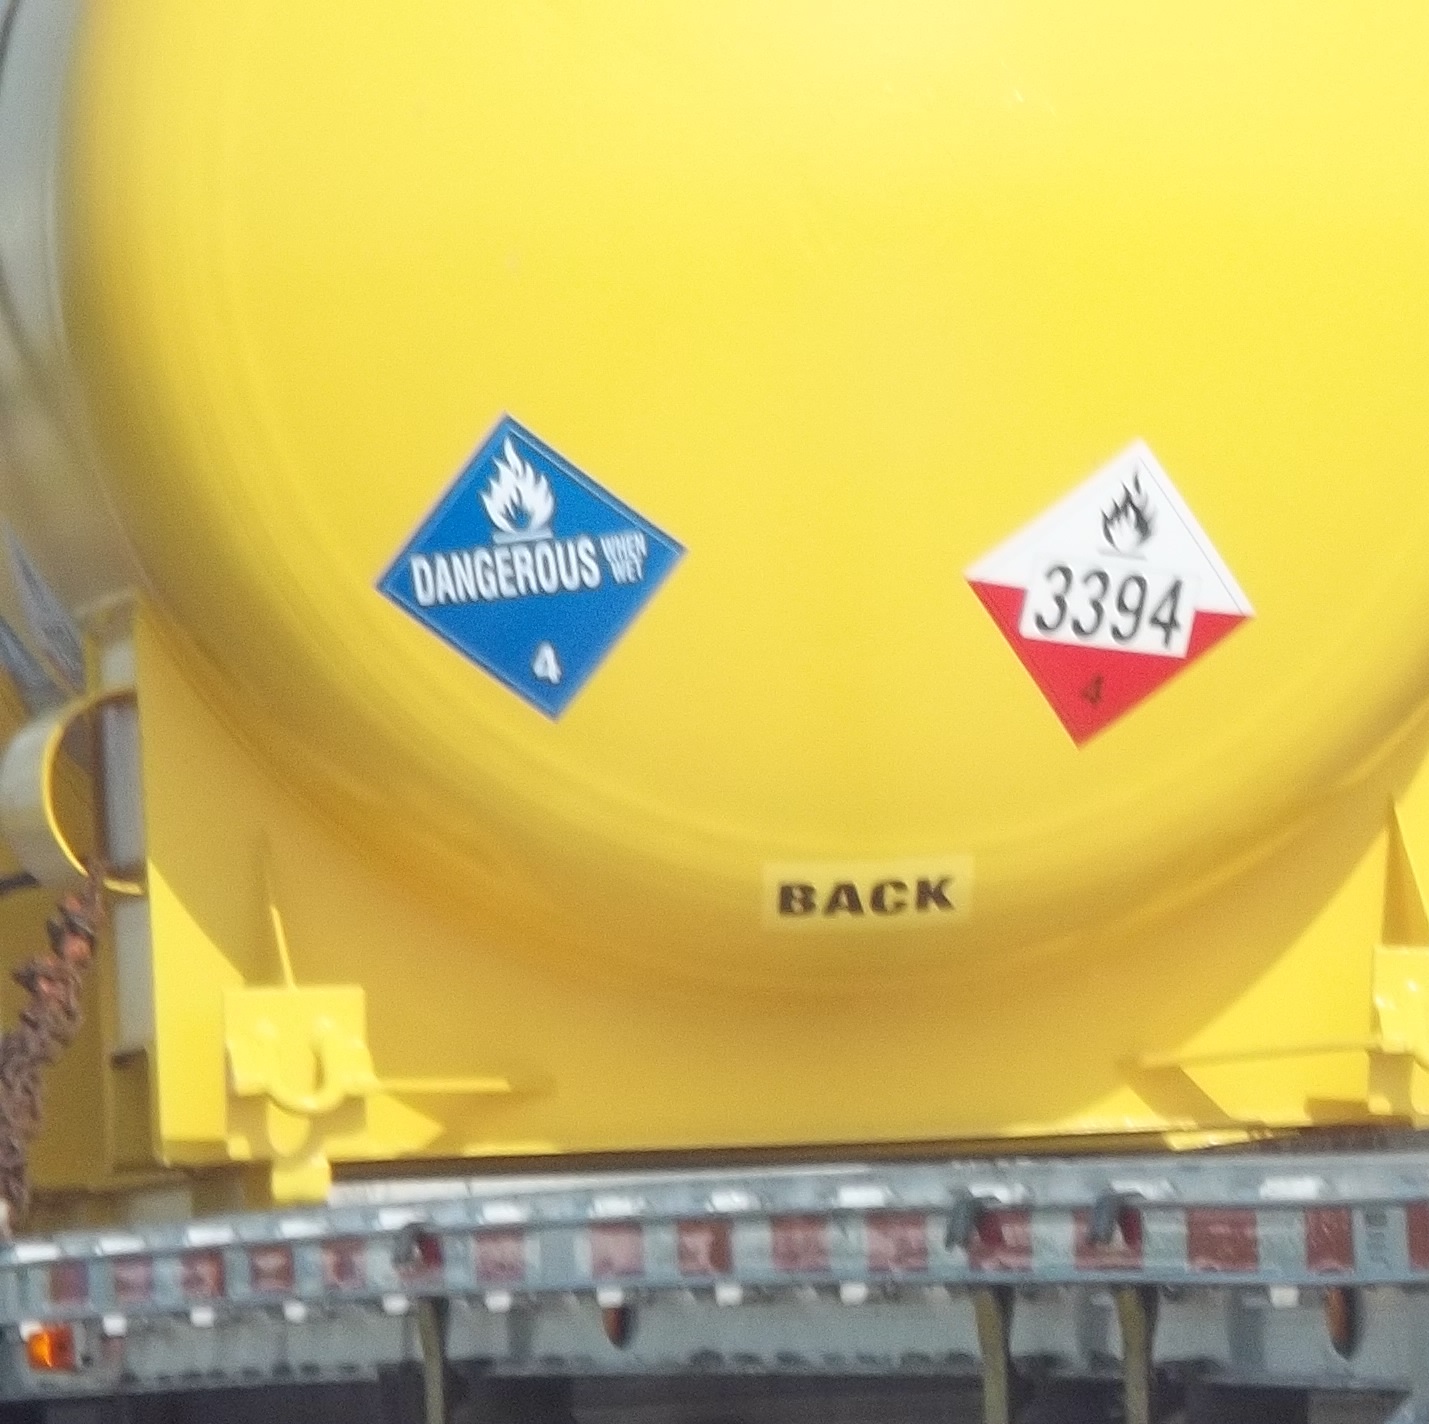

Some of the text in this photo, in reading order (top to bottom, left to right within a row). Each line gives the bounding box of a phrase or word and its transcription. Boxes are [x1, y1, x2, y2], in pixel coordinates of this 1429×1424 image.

[600, 531, 648, 562] WHEN
[410, 535, 602, 608] DANGEROUS
[610, 555, 645, 585] WET
[1034, 564, 1183, 648] 3394
[531, 641, 562, 685] 4
[1079, 673, 1104, 707] 4
[778, 875, 956, 918] BACK
